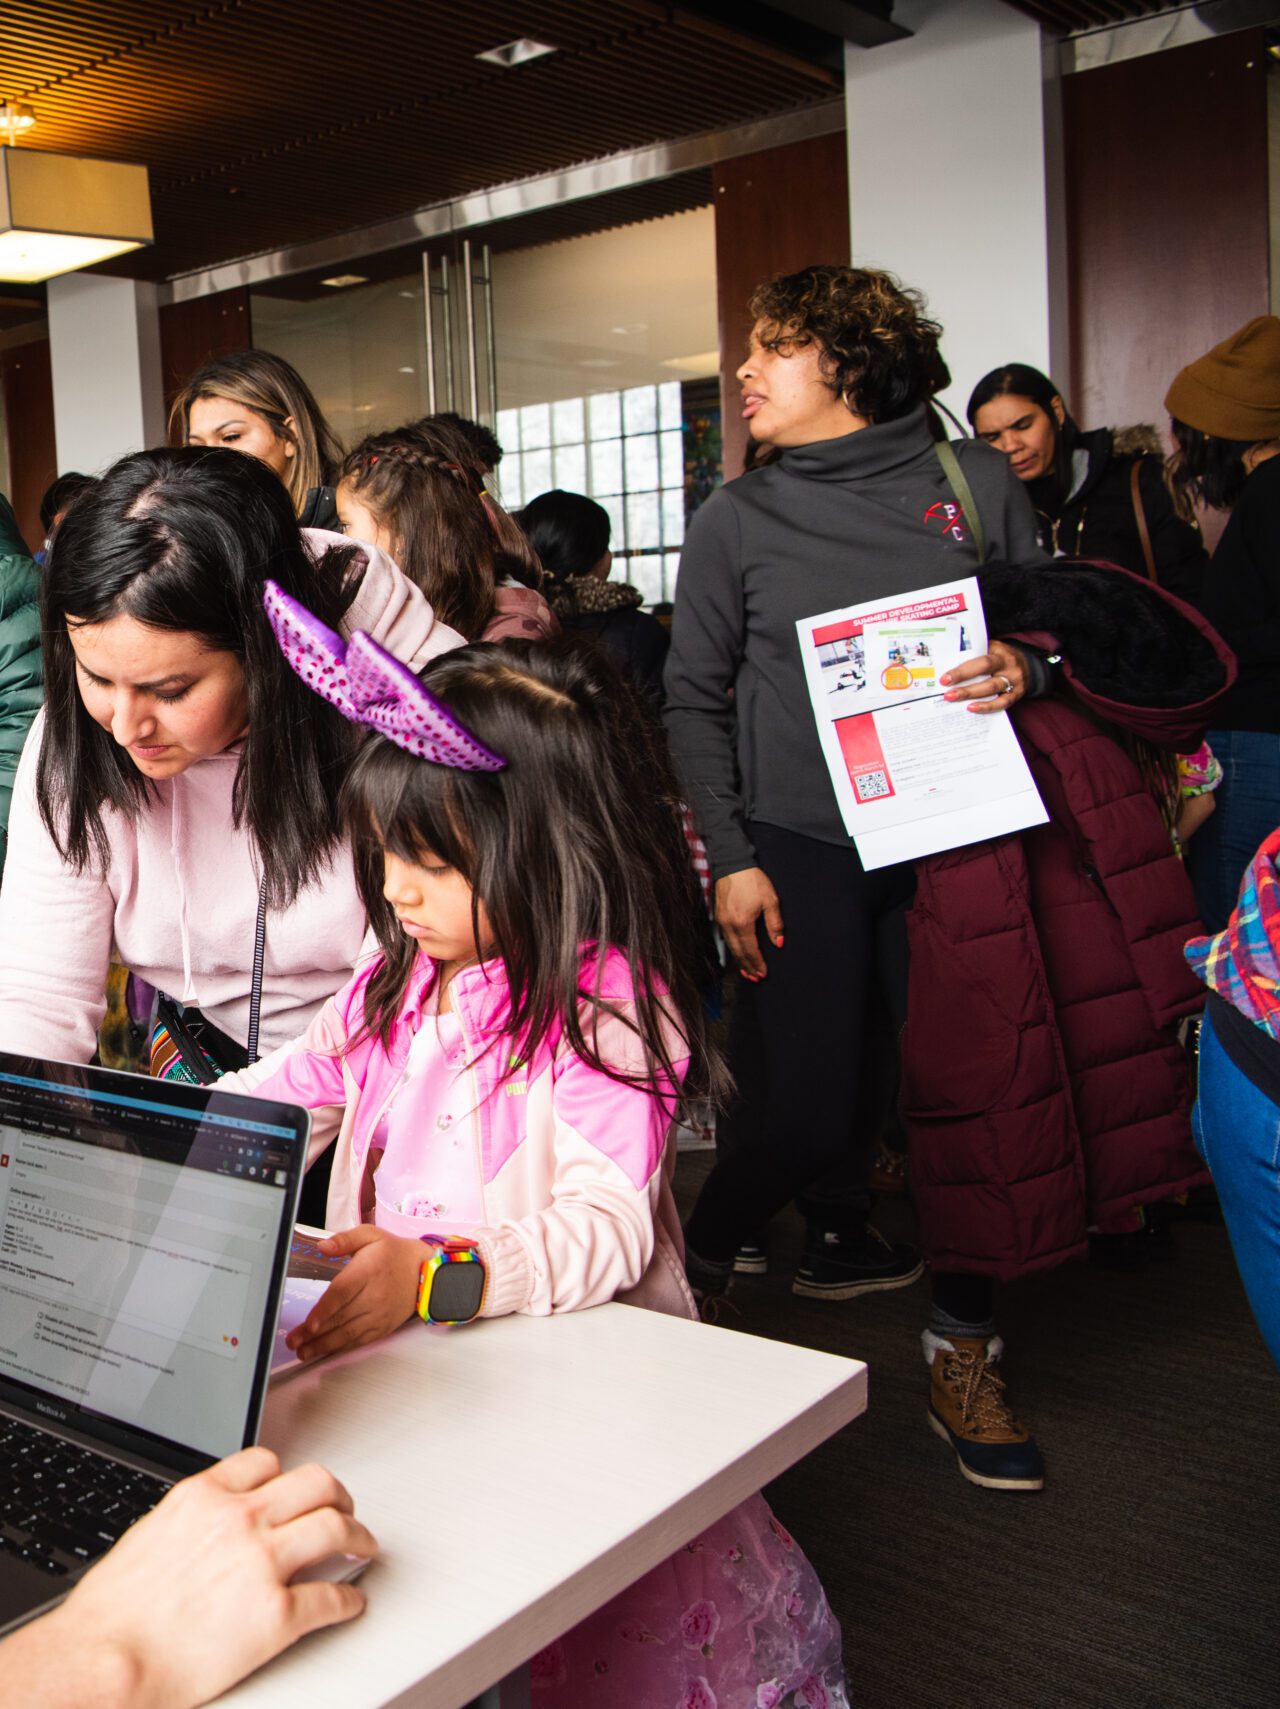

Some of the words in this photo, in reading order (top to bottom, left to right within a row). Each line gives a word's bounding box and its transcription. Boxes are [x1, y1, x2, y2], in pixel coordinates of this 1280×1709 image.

[852, 612, 888, 627] SUMMER
[888, 597, 959, 618] DEVELOPMENTAL
[900, 609, 935, 622] SKATING
[935, 603, 960, 614] CAMP
